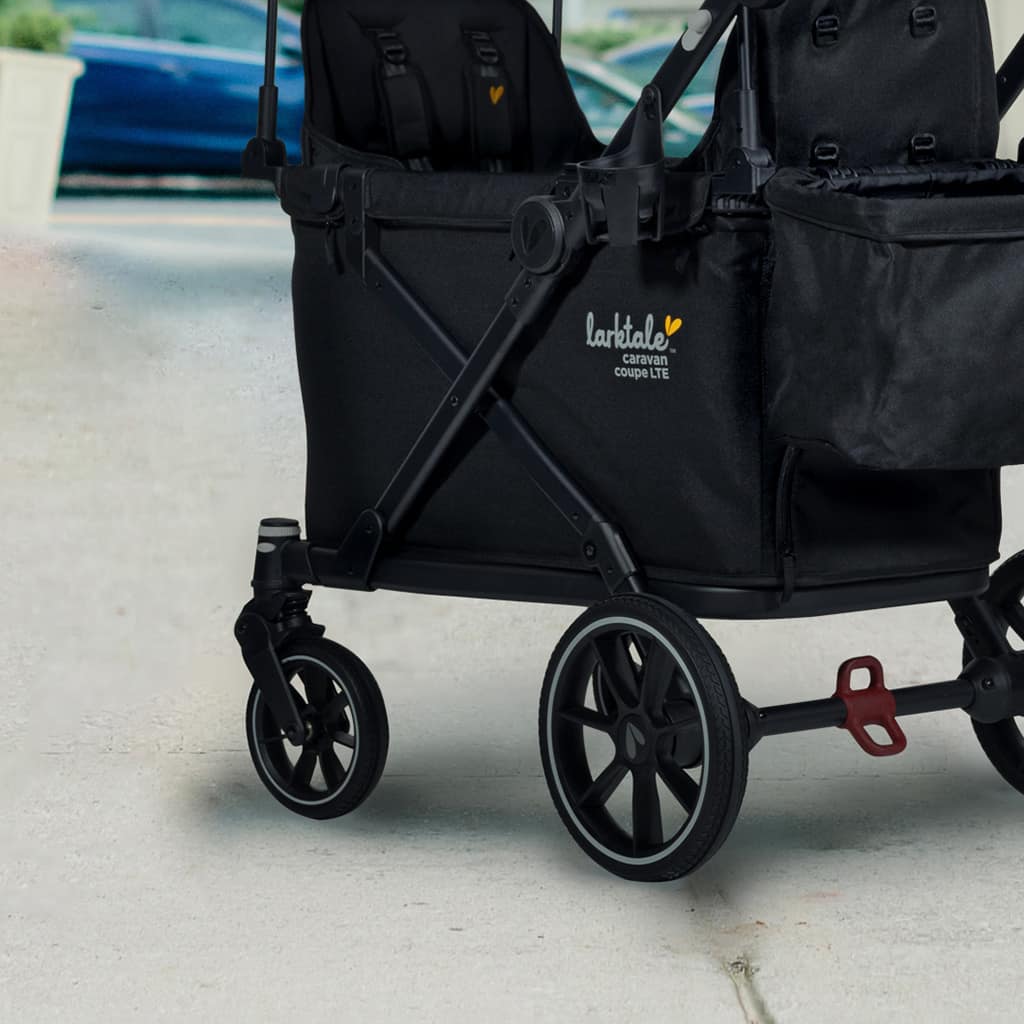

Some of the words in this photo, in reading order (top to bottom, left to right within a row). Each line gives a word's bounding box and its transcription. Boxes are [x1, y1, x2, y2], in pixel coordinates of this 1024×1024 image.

[586, 311, 669, 351] larktale
[622, 354, 668, 366] caravan
[614, 367, 649, 381] coupe
[650, 367, 669, 379] LTE
